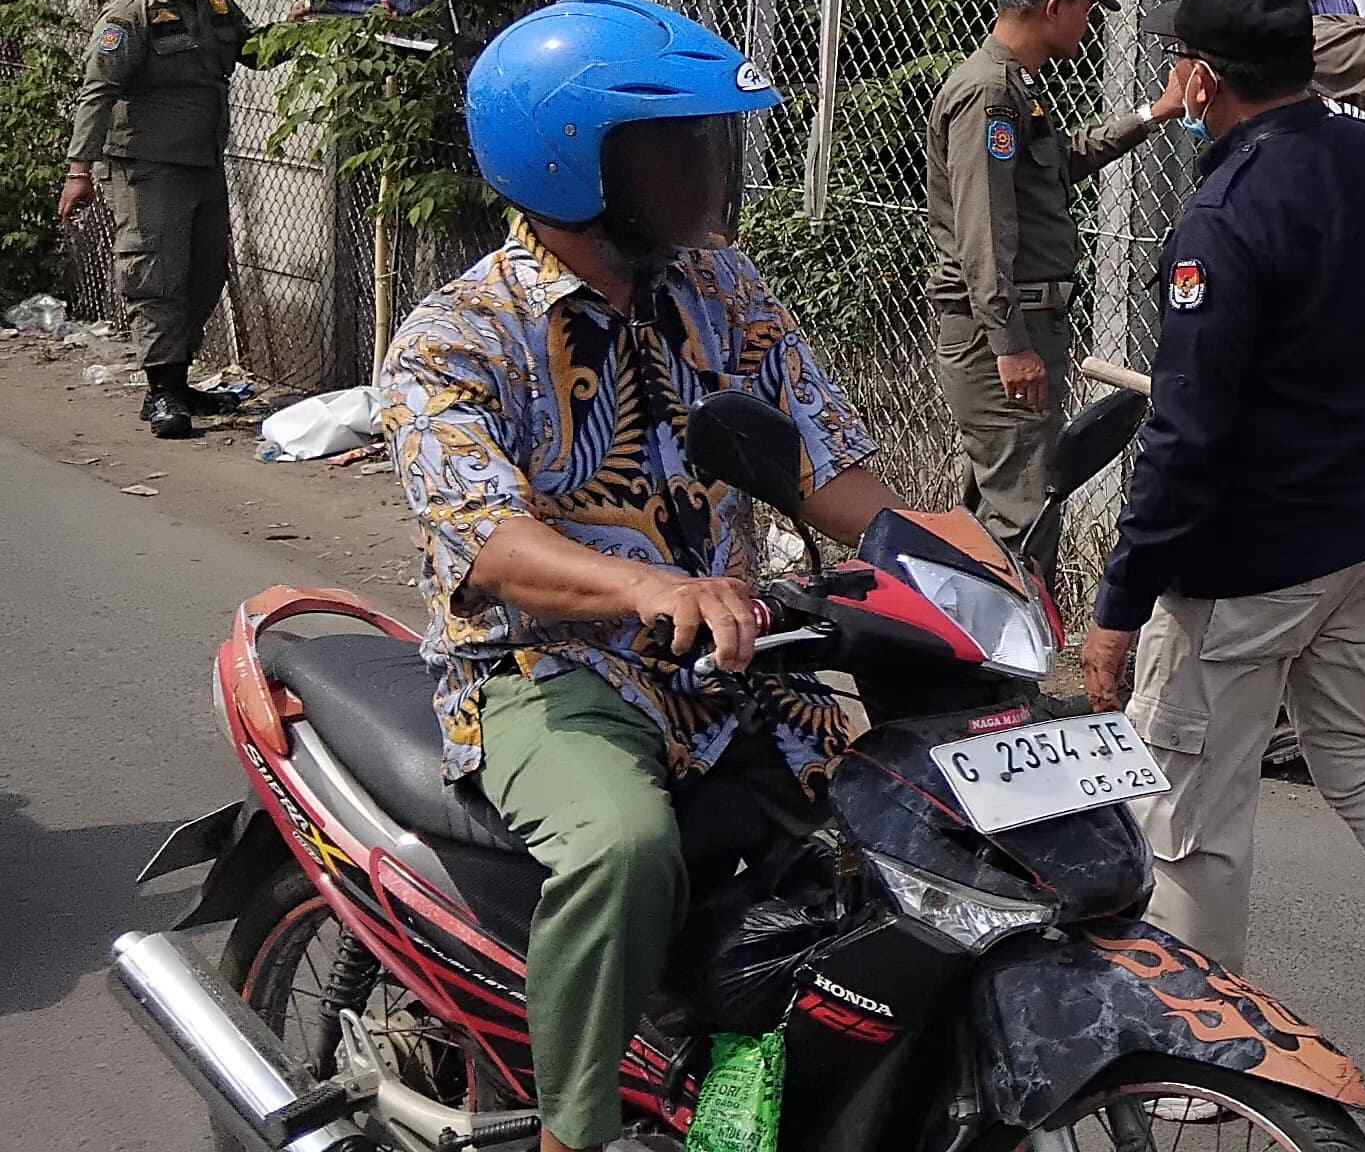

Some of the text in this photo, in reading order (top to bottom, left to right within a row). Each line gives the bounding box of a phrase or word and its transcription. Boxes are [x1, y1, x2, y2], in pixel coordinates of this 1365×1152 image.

[952, 722, 1133, 783] G 2354 JE
[797, 993, 895, 1044] 125
[814, 974, 894, 1017] HONDA
